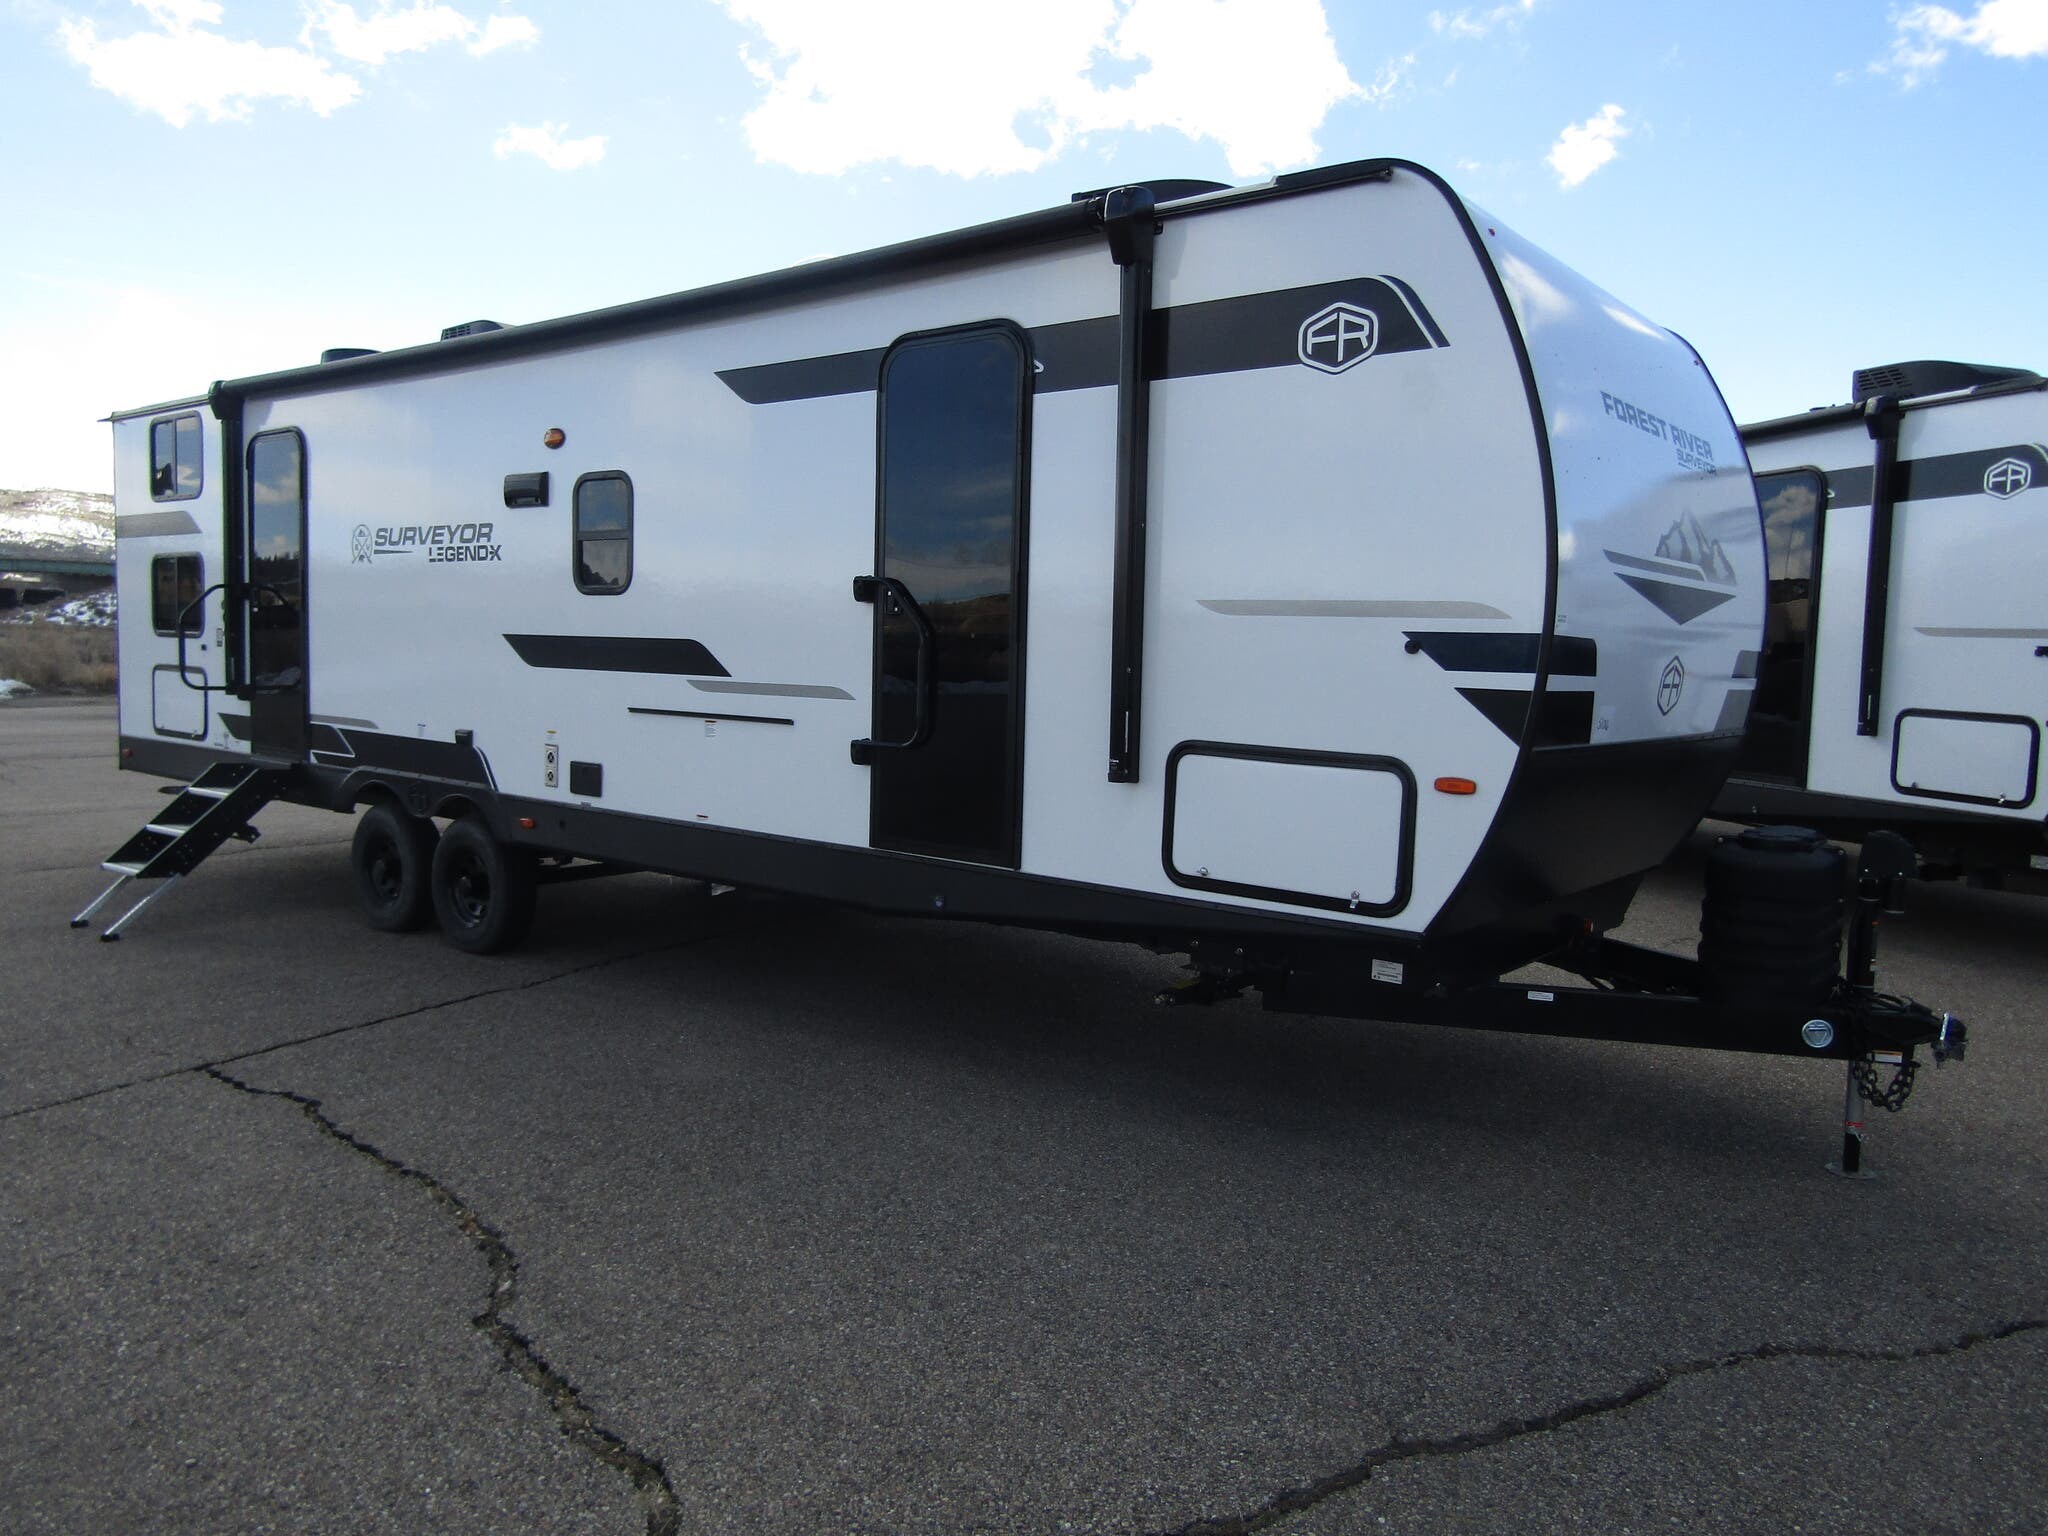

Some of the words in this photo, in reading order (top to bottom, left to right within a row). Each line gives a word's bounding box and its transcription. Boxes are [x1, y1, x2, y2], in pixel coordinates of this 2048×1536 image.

[1600, 390, 1668, 441] FOREST
[1669, 423, 1714, 462] RIVER
[374, 522, 494, 547] SURVEYOR
